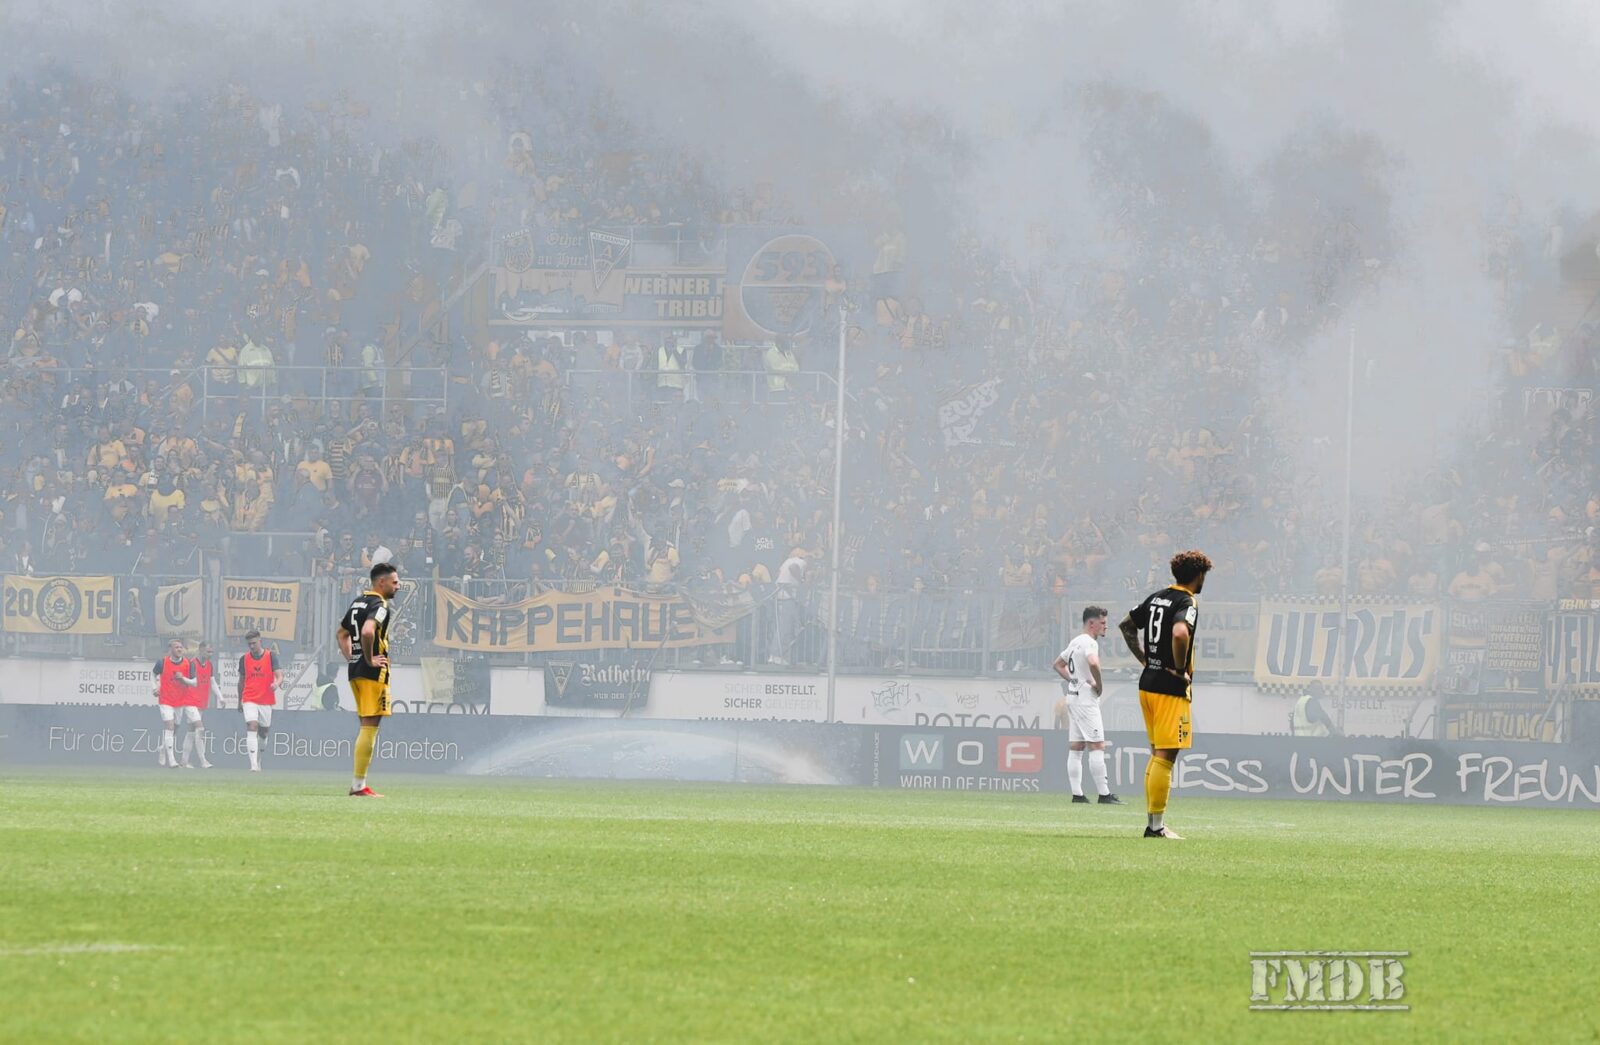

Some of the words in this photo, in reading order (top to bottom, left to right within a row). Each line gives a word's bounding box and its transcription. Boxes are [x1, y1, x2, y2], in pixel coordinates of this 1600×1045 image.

[227, 585, 292, 603] OECHER
[233, 615, 279, 633] KRAU
[351, 609, 361, 642] 5
[1148, 605, 1164, 644] 13
[1266, 608, 1434, 679] ULTRAS
[1068, 650, 1075, 674] 6
[79, 669, 115, 680] SICHER
[79, 684, 115, 695] SICHER
[724, 683, 762, 694] SICHER
[765, 684, 817, 696] BESTELLT.
[724, 697, 762, 709] SICHER
[48, 726, 85, 752] Für
[91, 727, 125, 754] die
[273, 732, 351, 758] Blauen
[376, 735, 465, 761] laneten.
[904, 740, 940, 765] W
[956, 740, 984, 766] O
[1005, 742, 1036, 769] F
[899, 775, 951, 788] WORLD
[955, 775, 975, 789] OF
[978, 777, 1040, 791] FITNESS
[1289, 751, 1436, 799] UNTER
